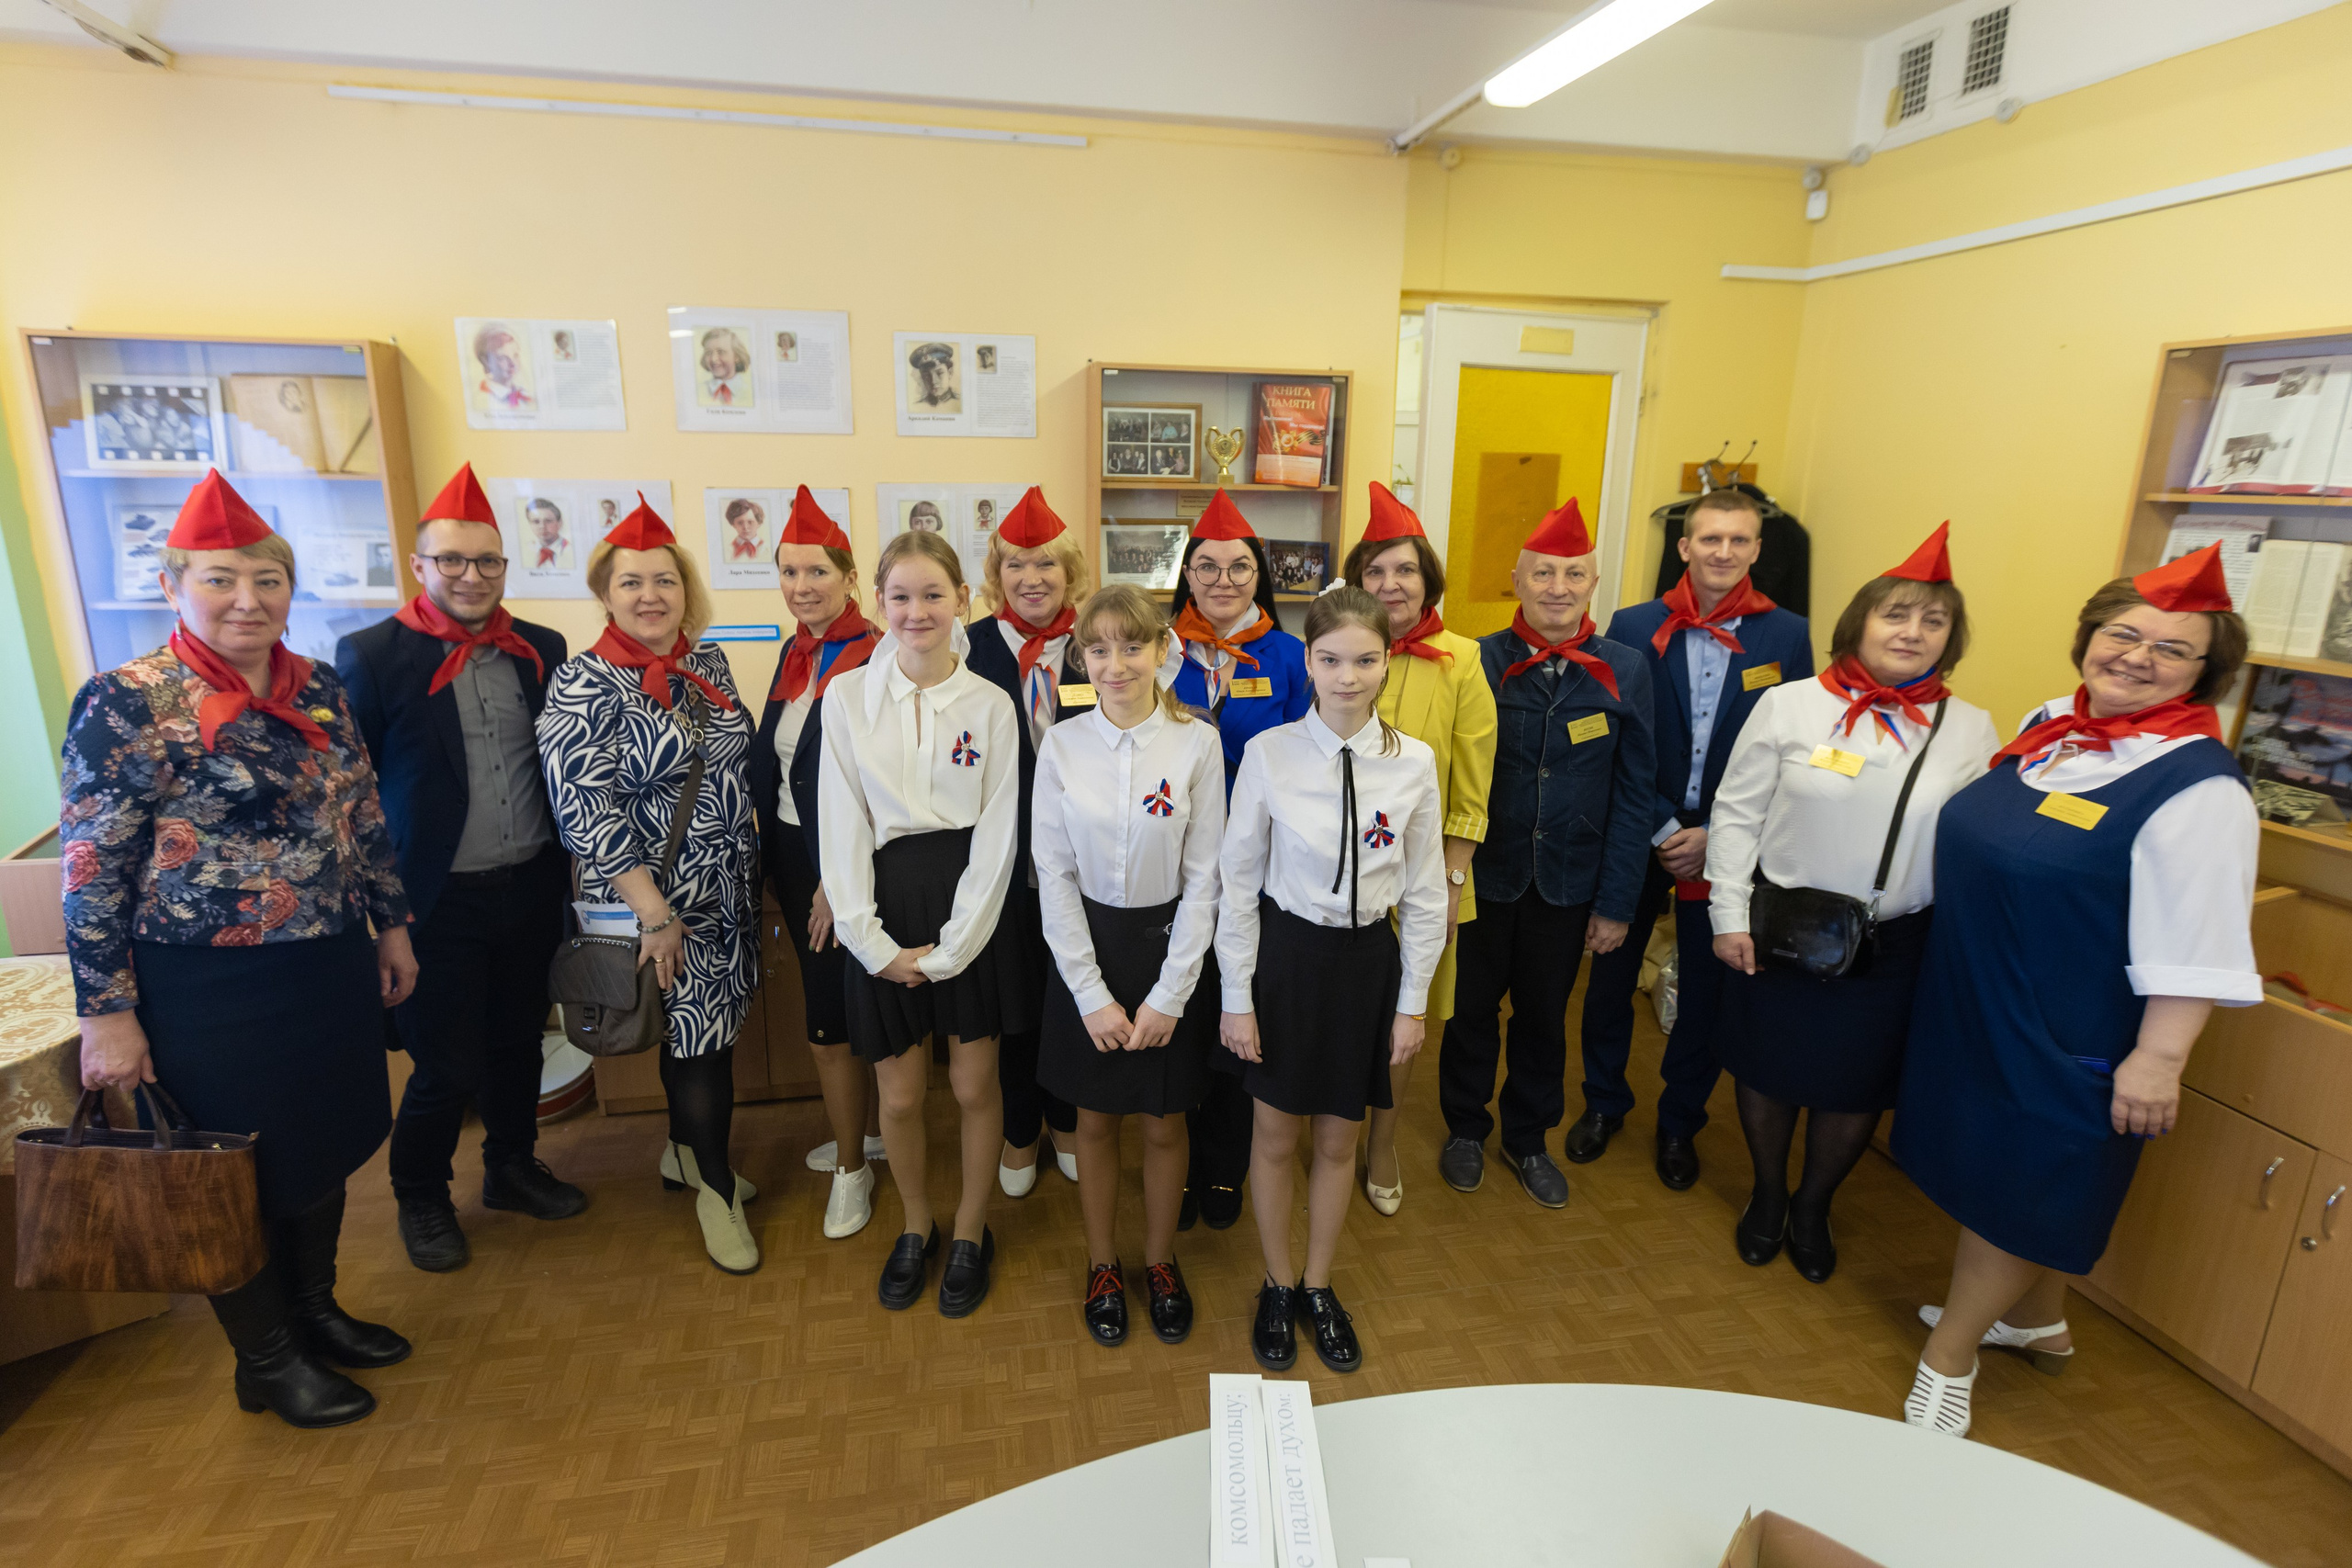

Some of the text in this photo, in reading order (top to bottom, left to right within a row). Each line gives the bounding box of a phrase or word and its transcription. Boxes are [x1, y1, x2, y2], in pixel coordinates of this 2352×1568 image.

[1266, 398, 1317, 410] ПАМЯТИ
[1272, 386, 1312, 397] КНИГА
[1227, 1393, 1249, 1546] комсомольцу;
[1285, 1465, 1312, 1546] падает
